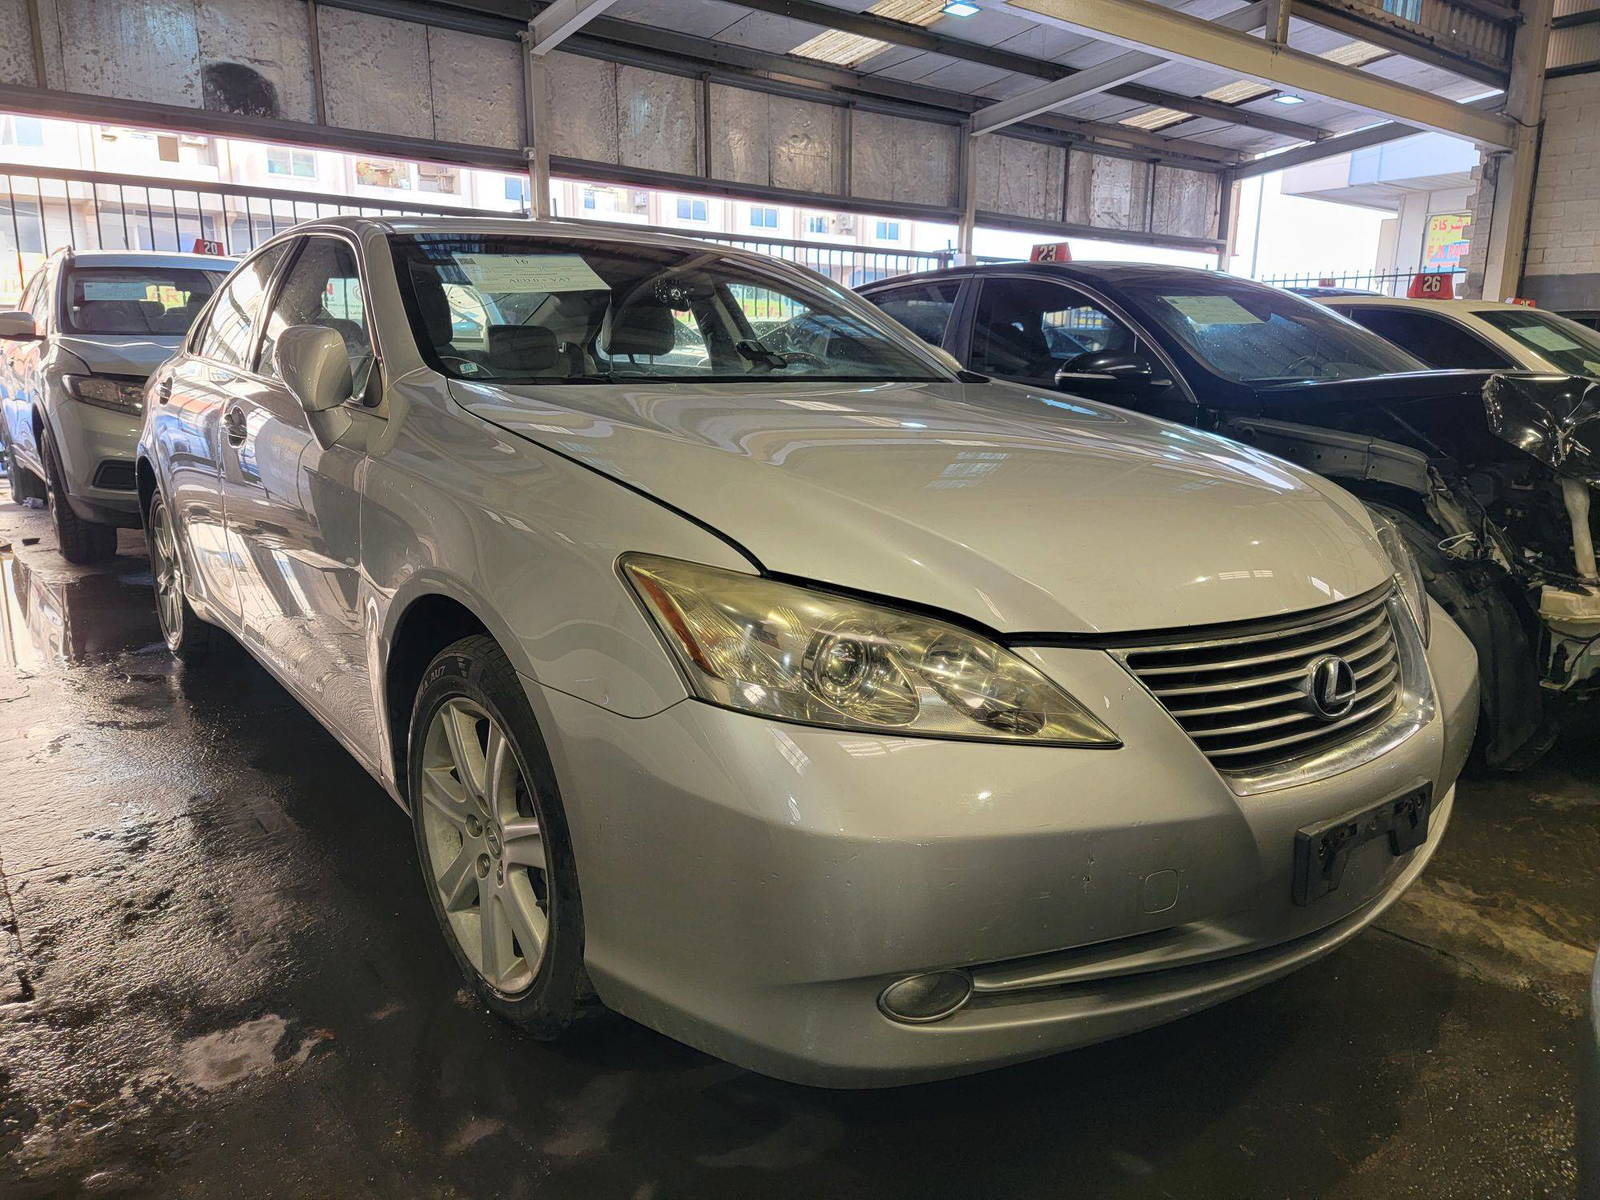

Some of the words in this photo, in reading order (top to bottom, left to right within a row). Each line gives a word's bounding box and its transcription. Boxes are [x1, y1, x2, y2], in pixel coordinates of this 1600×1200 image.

[204, 241, 218, 255] 20
[1039, 245, 1057, 263] 23
[1423, 276, 1441, 292] 26
